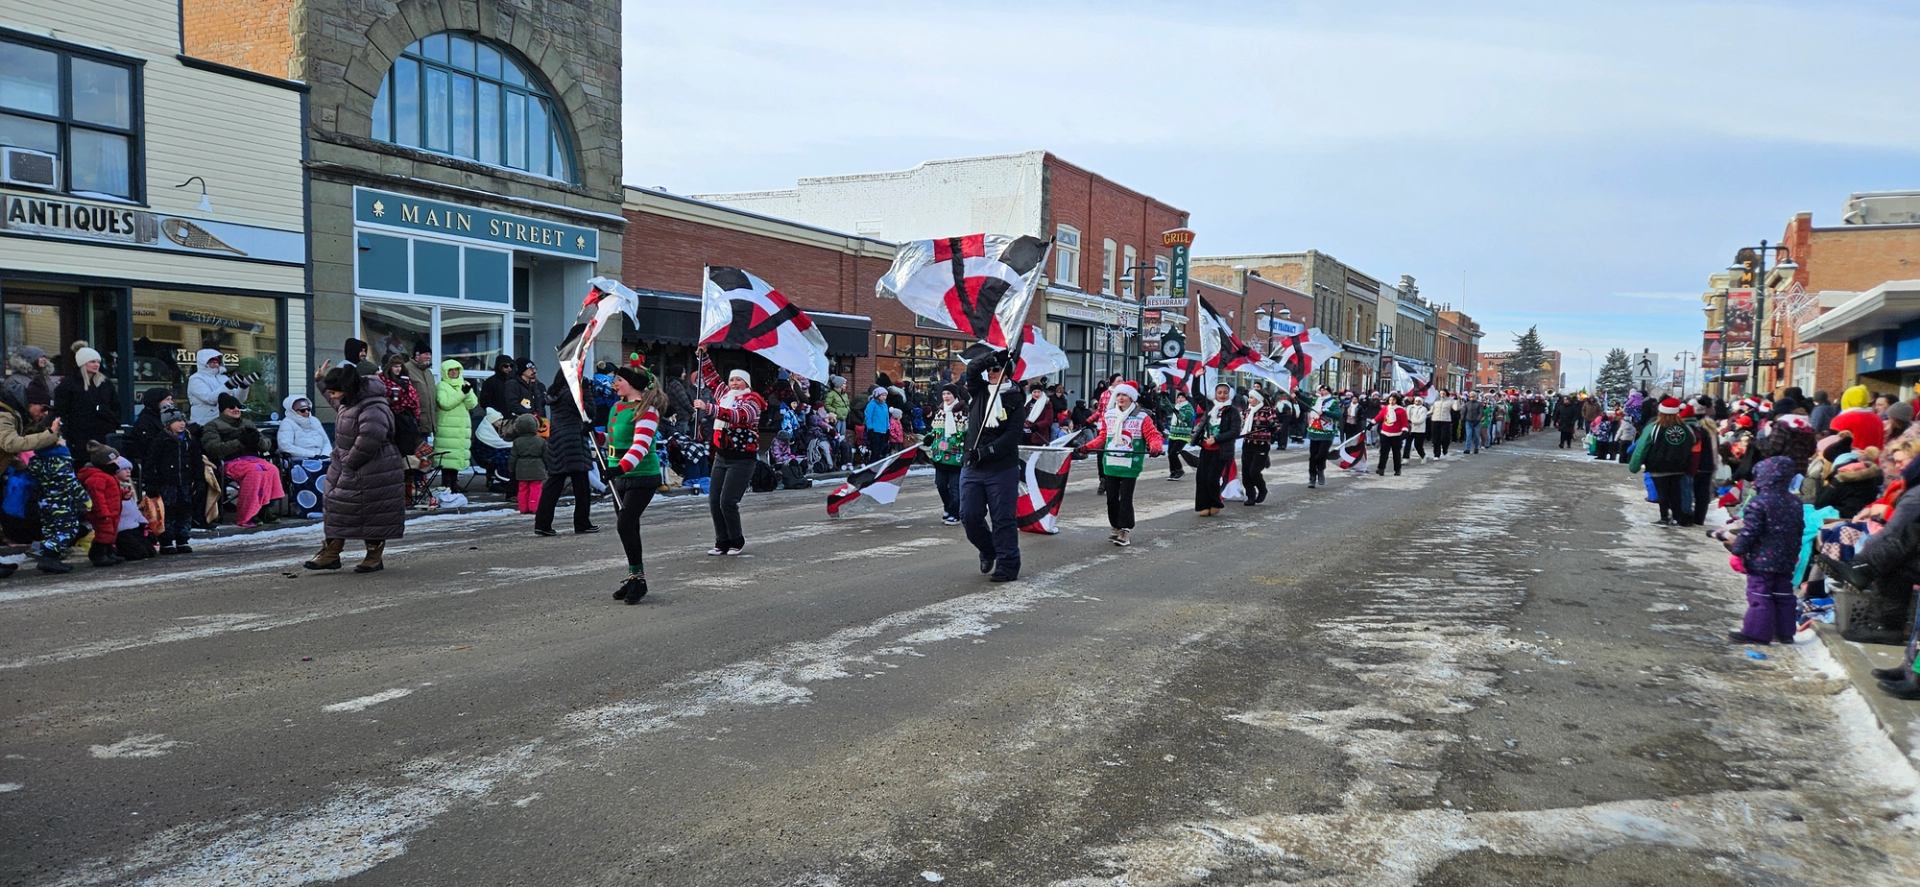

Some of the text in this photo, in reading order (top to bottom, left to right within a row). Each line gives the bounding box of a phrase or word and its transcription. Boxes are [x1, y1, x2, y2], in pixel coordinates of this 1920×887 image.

[8, 198, 134, 235] ANTIQUES
[400, 202, 565, 247] MAIN STREET
[1163, 232, 1191, 245] GRILL
[1175, 245, 1185, 288] CAFE
[1147, 298, 1186, 307] RESTAURANT
[176, 348, 239, 363] Anes
